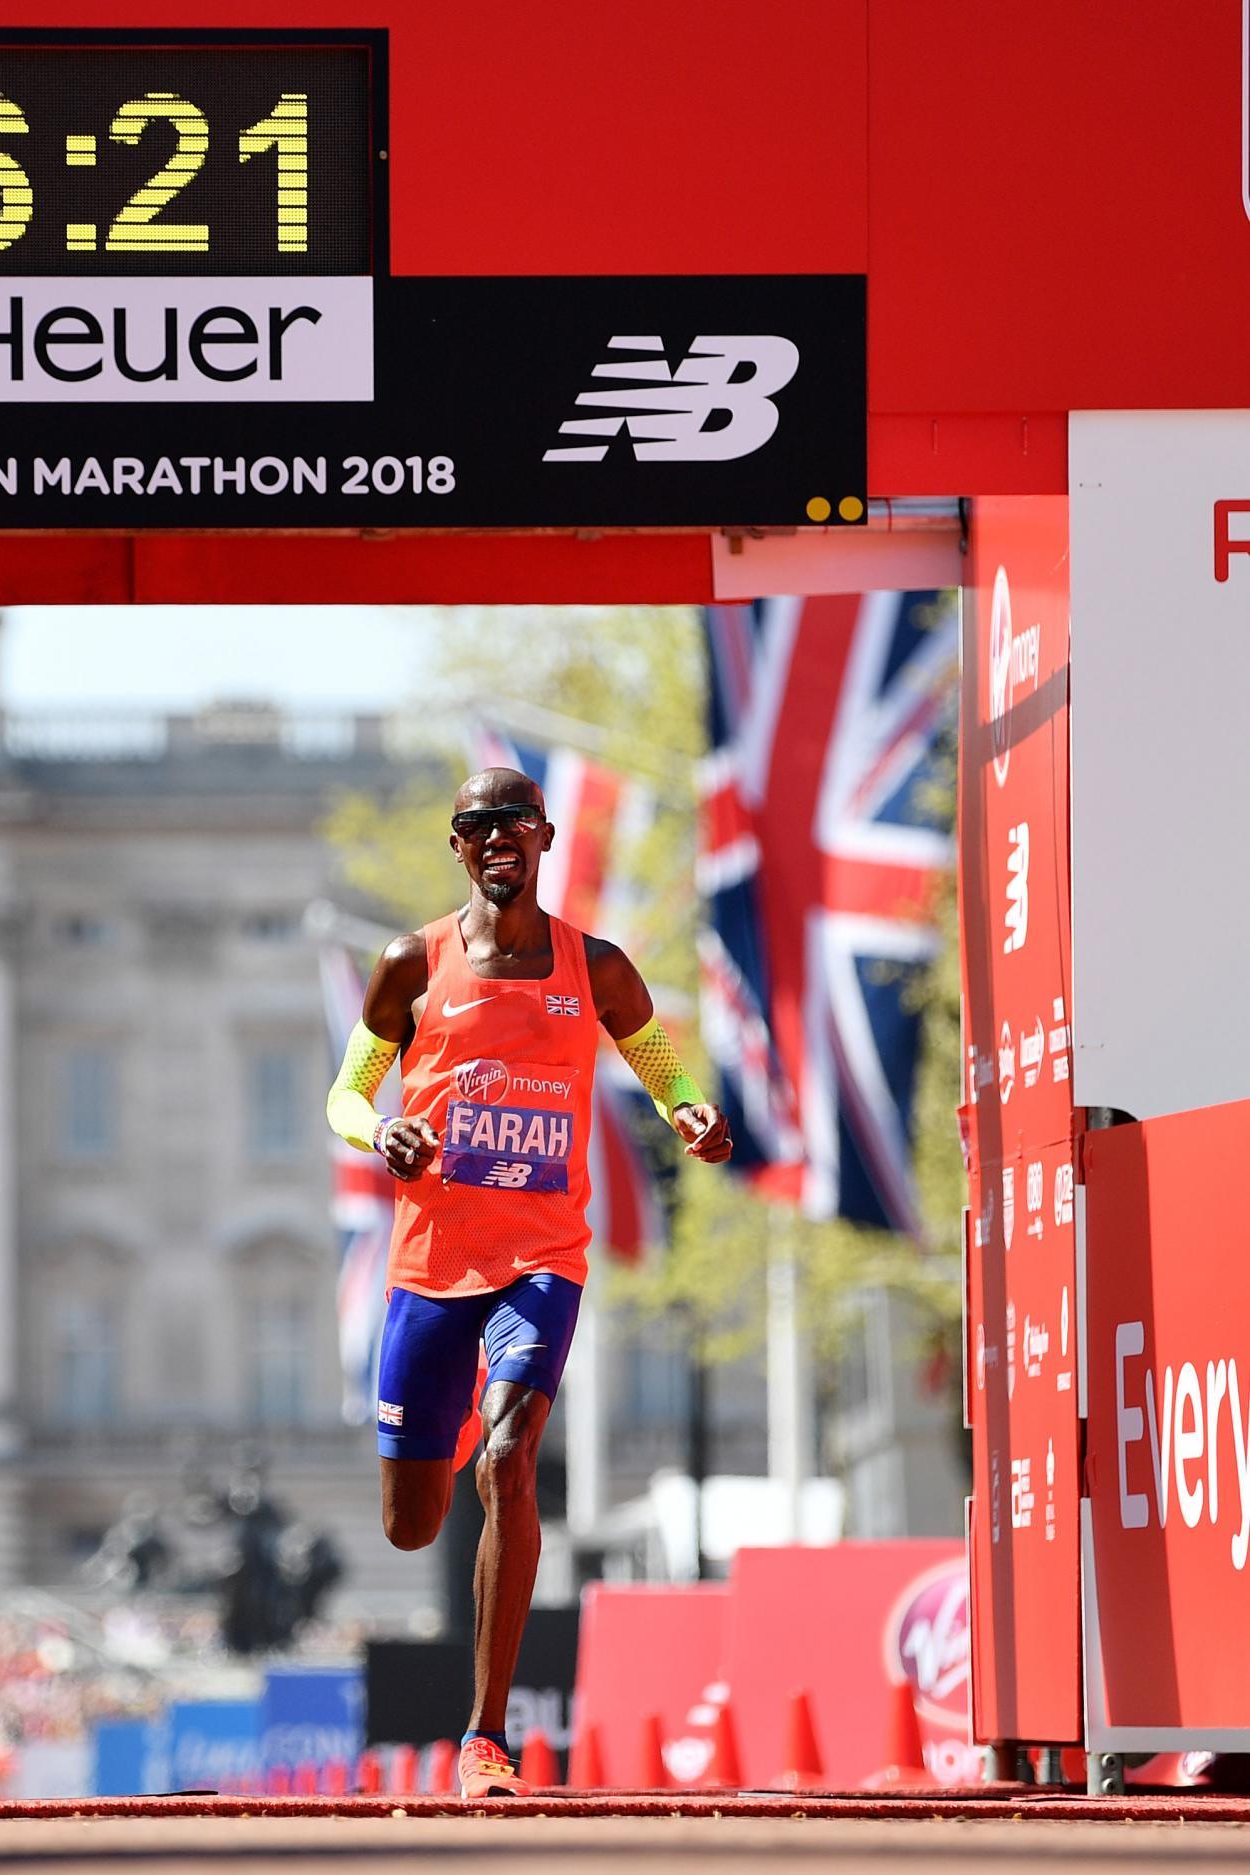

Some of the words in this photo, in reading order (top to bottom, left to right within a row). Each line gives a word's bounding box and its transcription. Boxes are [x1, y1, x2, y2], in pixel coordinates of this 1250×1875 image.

[33, 456, 327, 495] MARATHON
[341, 455, 456, 495] 2018
[458, 1066, 506, 1101] Virgin
[513, 1077, 571, 1100] money
[450, 1106, 568, 1157] FARAH
